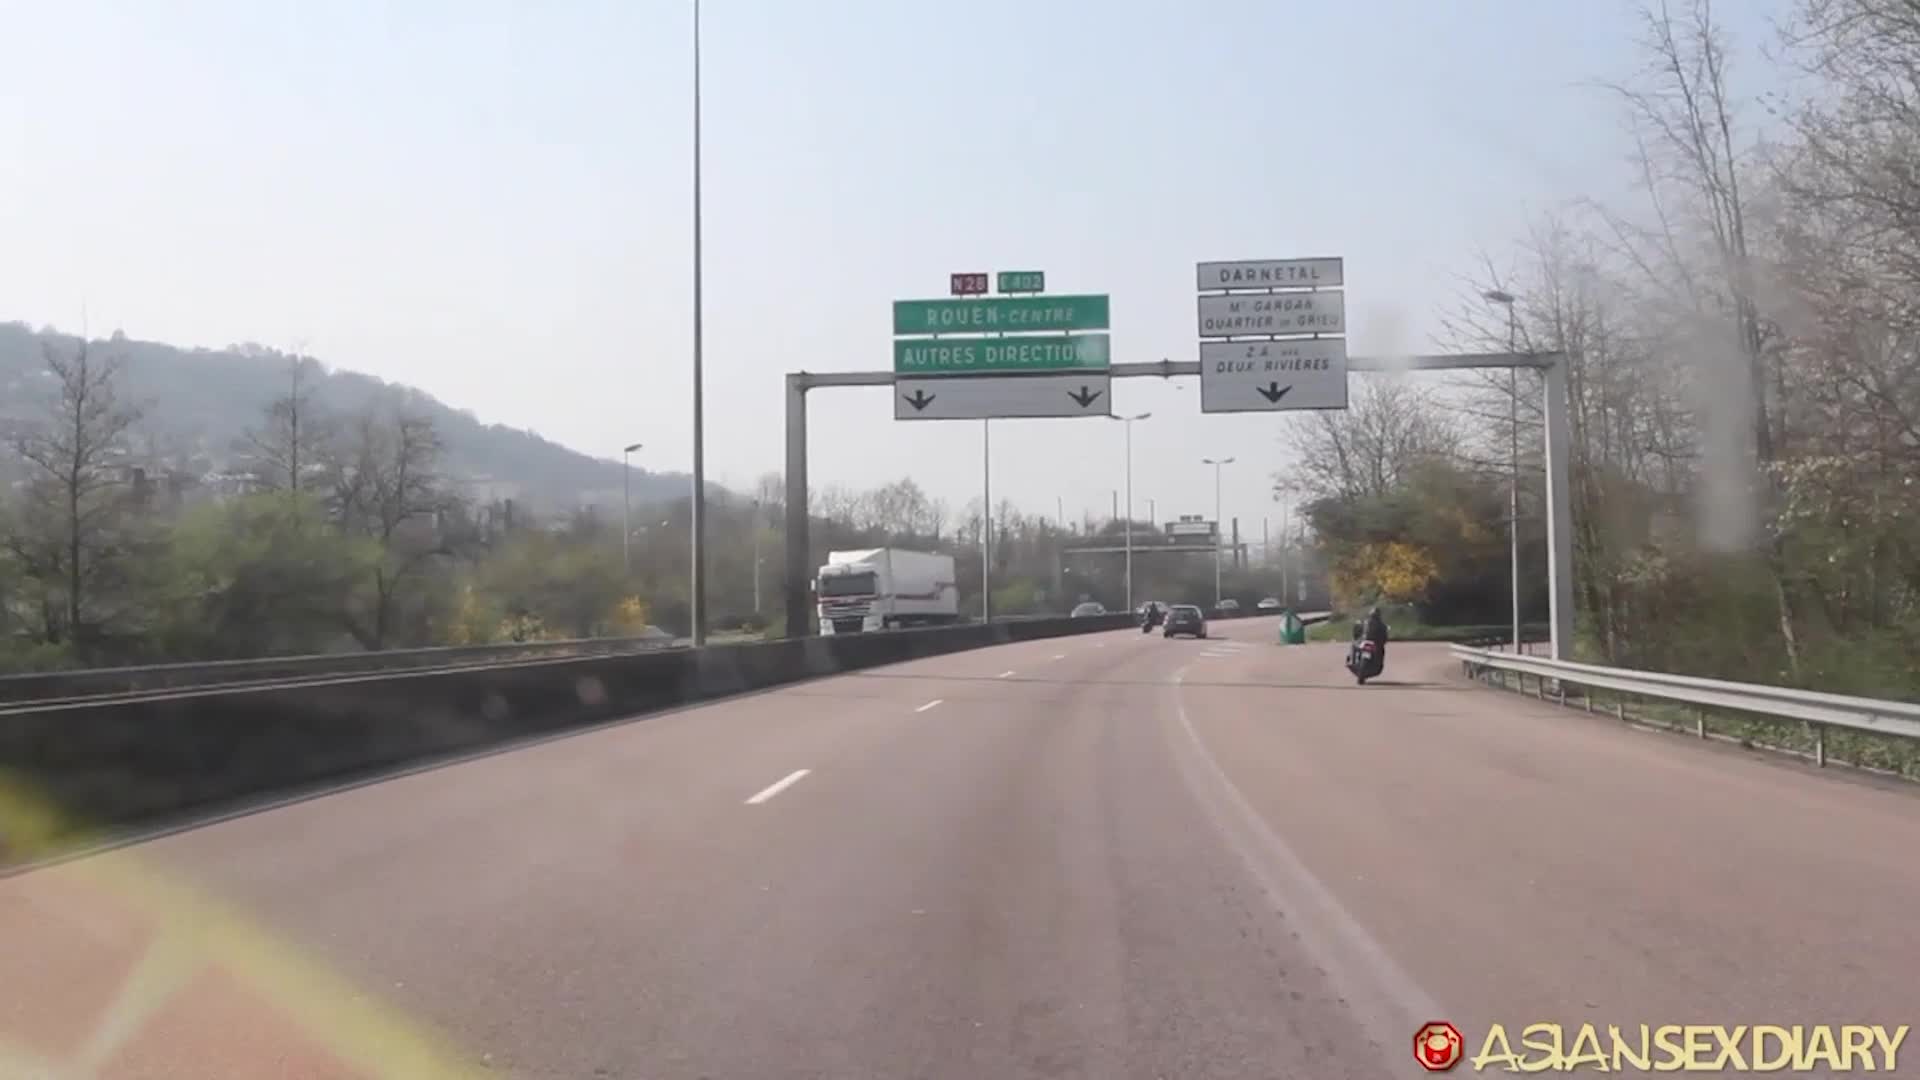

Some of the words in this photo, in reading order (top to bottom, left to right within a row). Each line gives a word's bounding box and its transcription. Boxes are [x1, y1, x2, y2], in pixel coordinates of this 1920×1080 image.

[1219, 266, 1321, 283] DARNETAL
[1204, 316, 1273, 330] QUARTIER
[902, 346, 977, 366] AUTRES
[1215, 360, 1256, 373] DEUX
